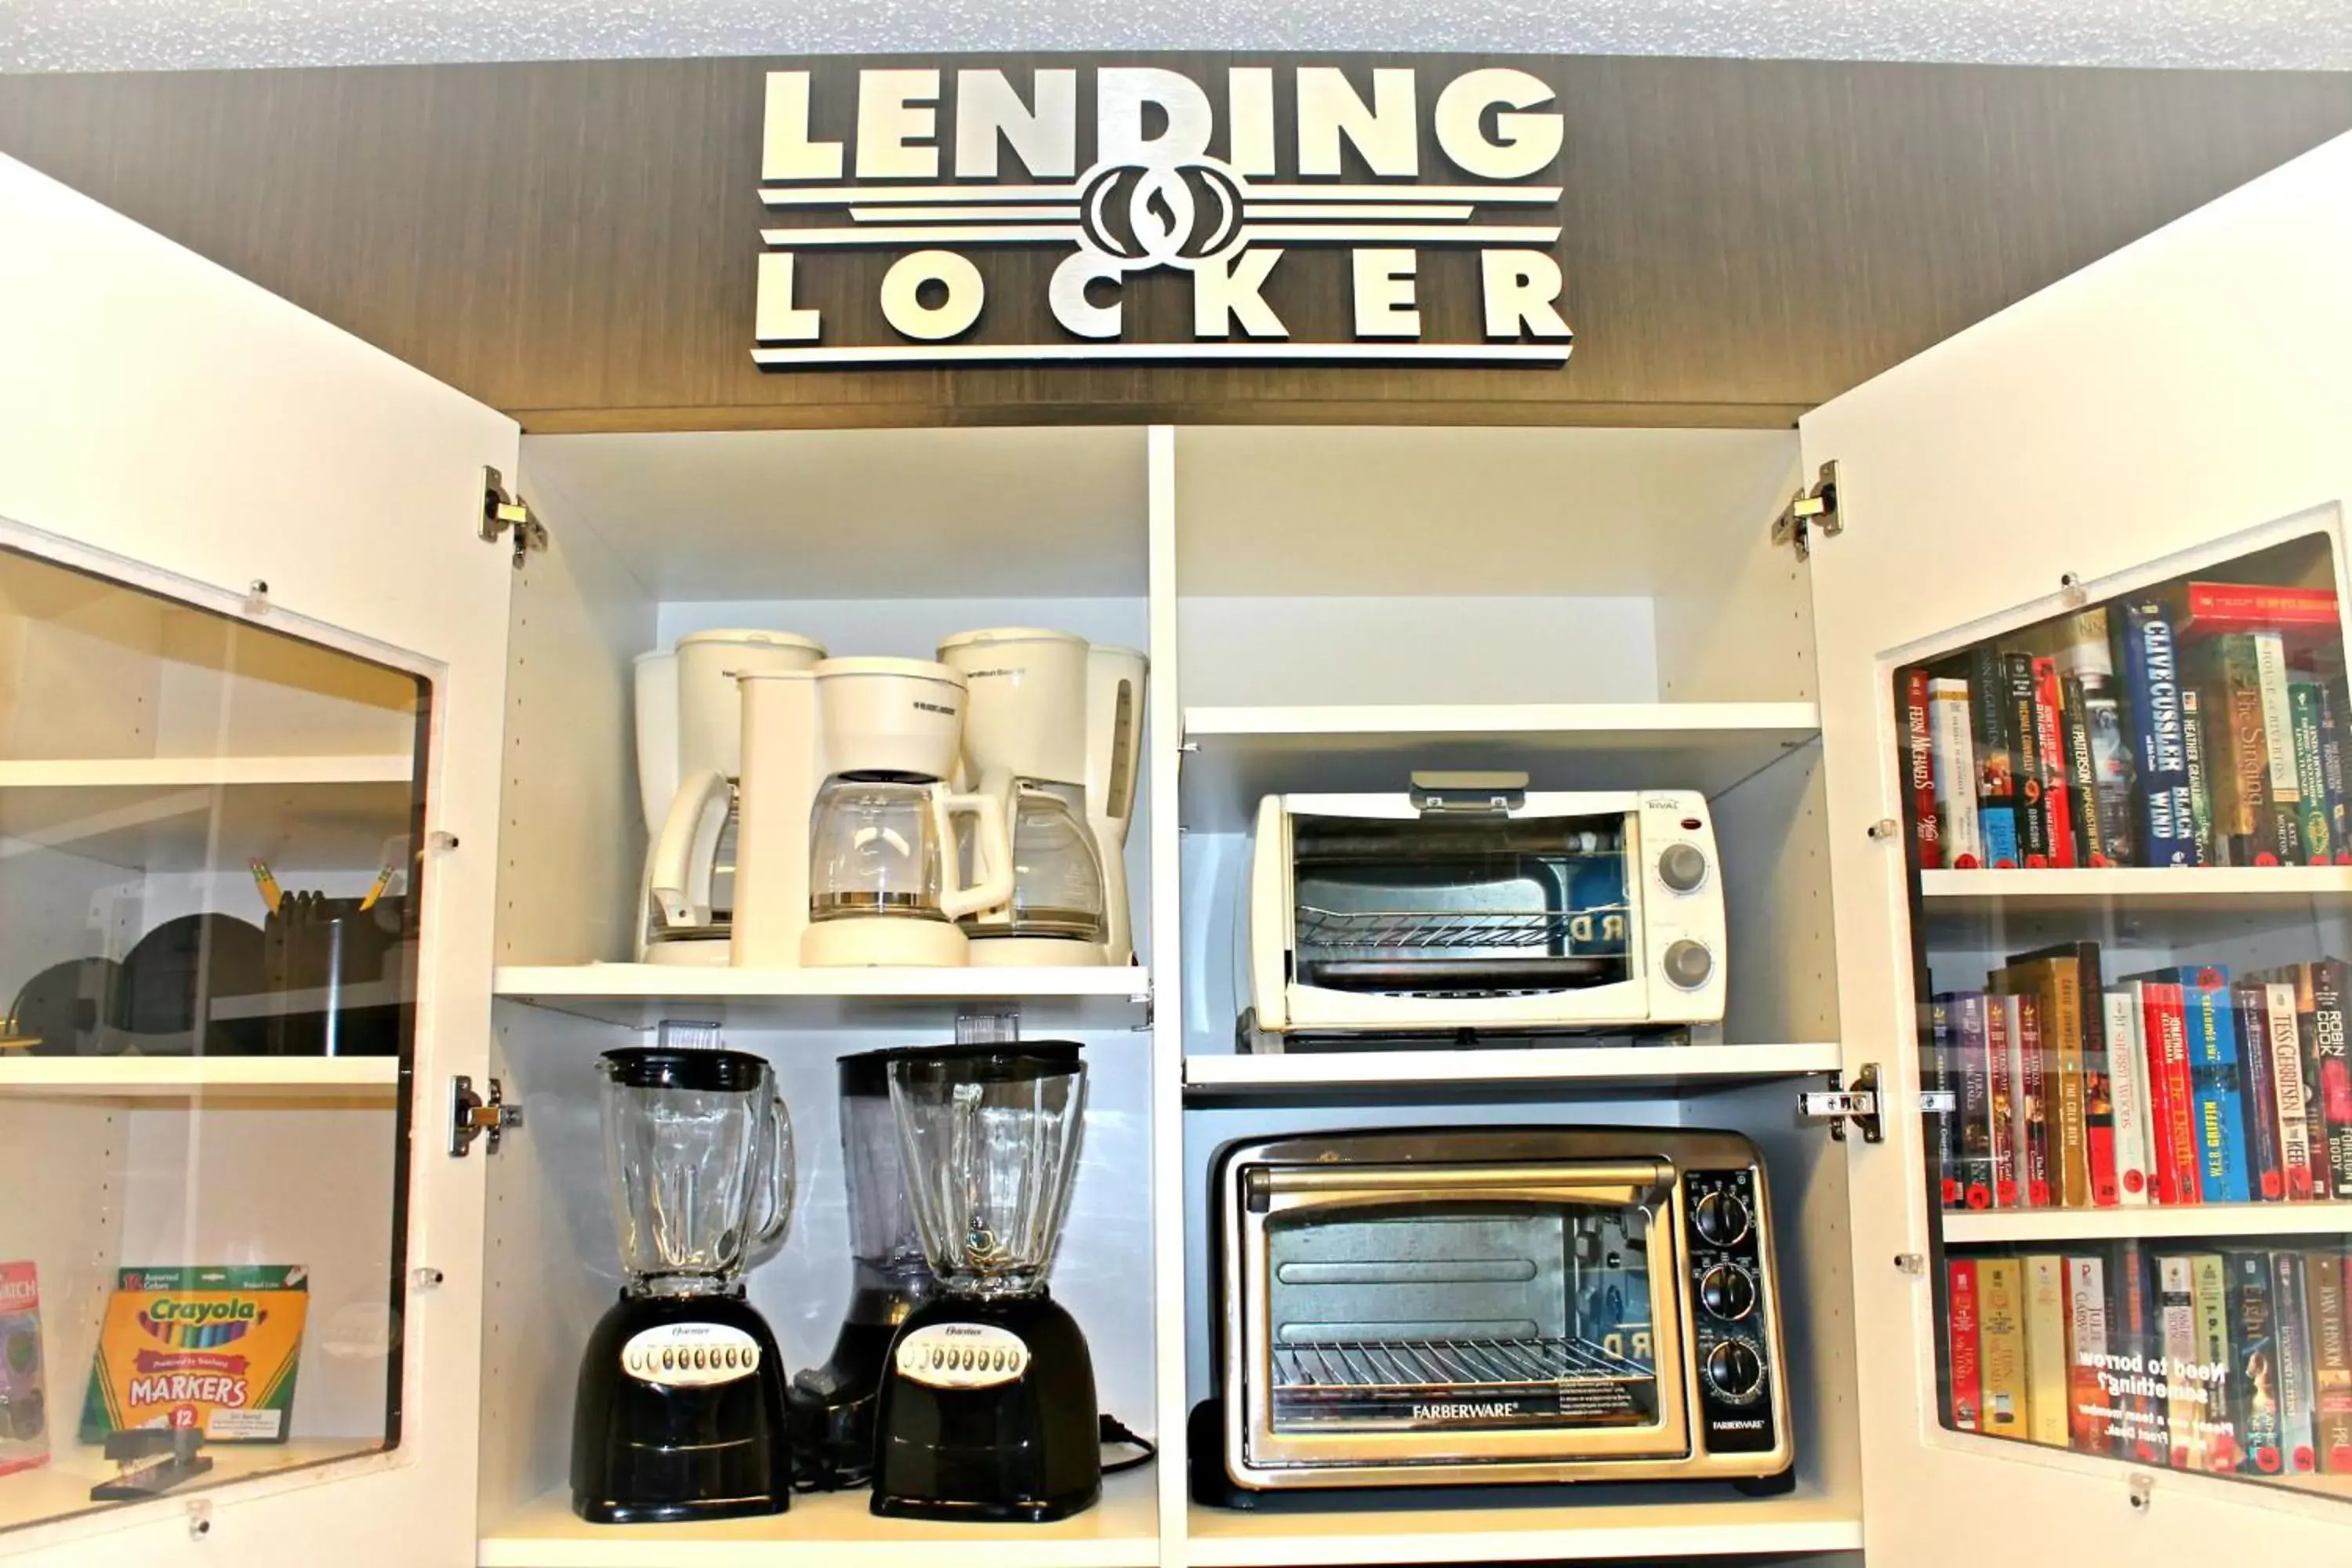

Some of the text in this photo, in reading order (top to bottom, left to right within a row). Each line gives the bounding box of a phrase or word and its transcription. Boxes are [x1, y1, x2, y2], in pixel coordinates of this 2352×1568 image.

[761, 67, 1565, 180] LENDING
[755, 248, 1573, 341] LOCKER
[2018, 700, 2031, 732] MICHAEL
[2143, 620, 2184, 772] CLIVE CUSSLER
[1908, 706, 1925, 735] FERN
[2183, 719, 2198, 760] HEATHER
[1911, 735, 1934, 789] MICHAELS
[2072, 730, 2092, 784] PATTERSON
[2238, 690, 2265, 806] The Singing
[1648, 800, 1679, 810] RIVAL
[2028, 808, 2041, 848] DRAGONS
[2149, 790, 2173, 838] WIND
[2172, 786, 2193, 839] BLACK
[2169, 1017, 2183, 1062] JONATHAN
[2317, 1011, 2334, 1056] COOK
[2327, 1010, 2346, 1056] ROBIN
[2273, 1013, 2301, 1112] TESS GERRITSEN
[2118, 1083, 2131, 1129] WOODS
[2203, 1102, 2220, 1148] GRIFFIN
[2172, 1114, 2195, 1167] Death
[2285, 1140, 2306, 1168] KEEP
[2328, 1137, 2342, 1171] BODY
[2340, 1127, 2352, 1181] FOREIGN
[149, 1298, 256, 1324] Crayola
[2241, 1283, 2265, 1341] Eight
[2318, 1286, 2336, 1313] JOAN
[2086, 1307, 2103, 1343] JULIE
[130, 1375, 247, 1407] MARKERS
[176, 1410, 193, 1426] 12
